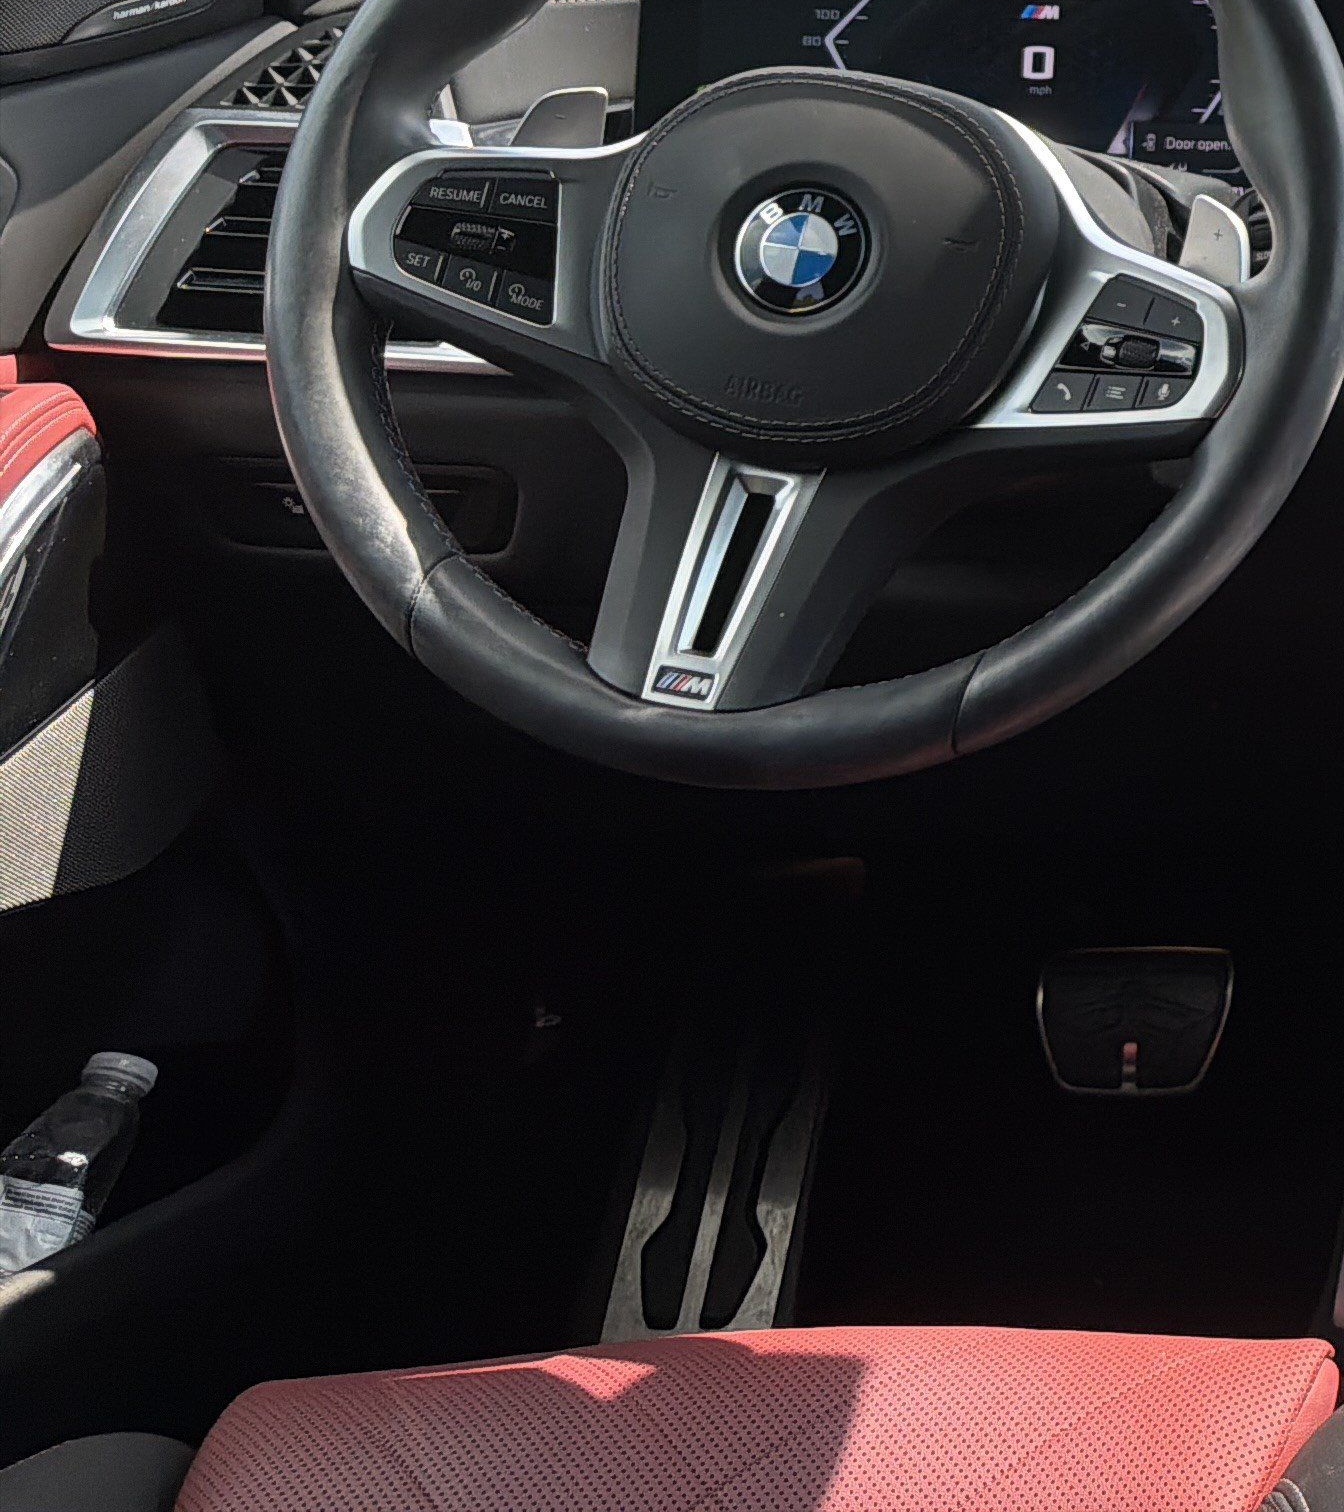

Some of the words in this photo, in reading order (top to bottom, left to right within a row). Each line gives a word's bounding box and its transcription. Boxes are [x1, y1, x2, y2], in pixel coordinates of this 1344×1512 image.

[814, 8, 841, 20] 100
[802, 36, 822, 47] 80
[1021, 45, 1055, 80] 0
[1029, 85, 1053, 96] mph
[1164, 136, 1195, 151] Door
[1197, 138, 1231, 153] open.
[429, 186, 482, 203] RESUME
[499, 193, 548, 209] CANCEL
[760, 193, 857, 236] BMW
[406, 252, 431, 268] SET
[512, 293, 544, 311] MODE
